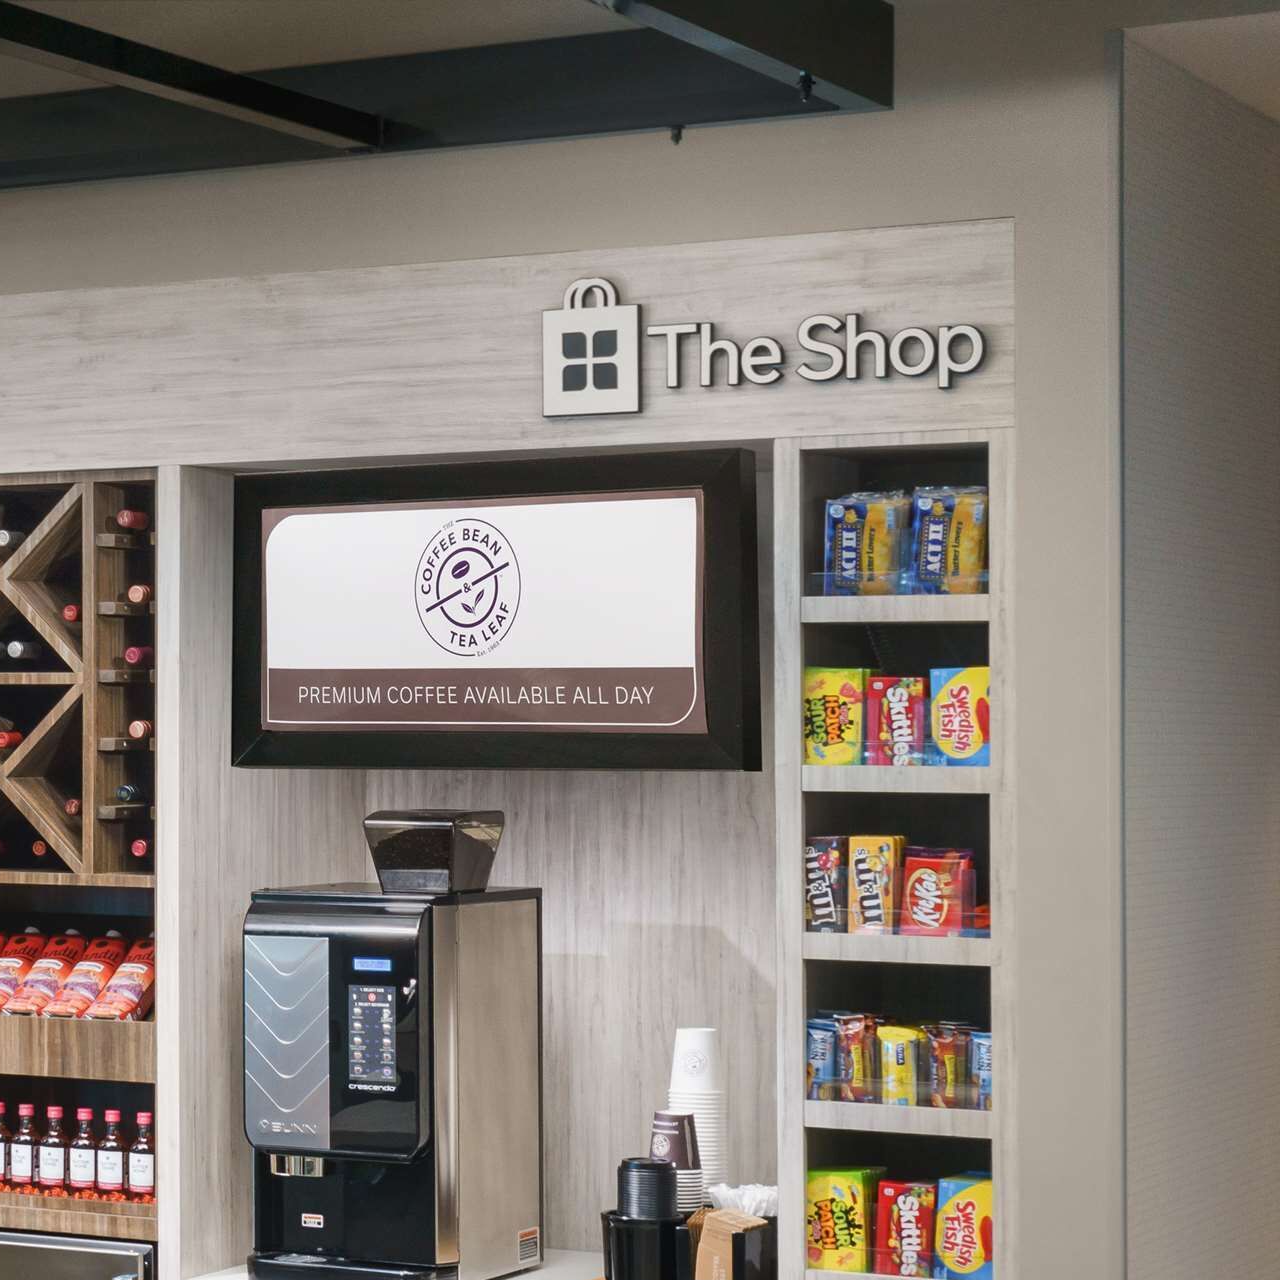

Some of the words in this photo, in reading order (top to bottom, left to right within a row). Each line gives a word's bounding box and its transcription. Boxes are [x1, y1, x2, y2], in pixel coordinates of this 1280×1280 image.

[646, 322, 785, 389] The
[796, 313, 986, 389] Shop
[421, 532, 457, 594] COFFEE
[462, 528, 502, 556] BEAN
[462, 582, 472, 593] &
[449, 630, 478, 647] TEA
[481, 601, 510, 642] LEAF
[298, 686, 381, 704] PREMIUM
[387, 686, 458, 704] COFFEE
[464, 686, 566, 705] AVAILABLE
[573, 686, 608, 705] ALL
[615, 686, 654, 705] DAY
[811, 697, 826, 744] SOUR
[824, 695, 842, 746] PATCH
[941, 701, 956, 739] Fish
[950, 685, 974, 751] Swedish
[886, 687, 913, 766] Skittles
[815, 1199, 837, 1250] PATCH
[832, 1200, 850, 1249] SOUR
[896, 1195, 921, 1276] Skittles
[942, 1216, 960, 1252] Fish
[955, 1200, 977, 1267] Swedish
